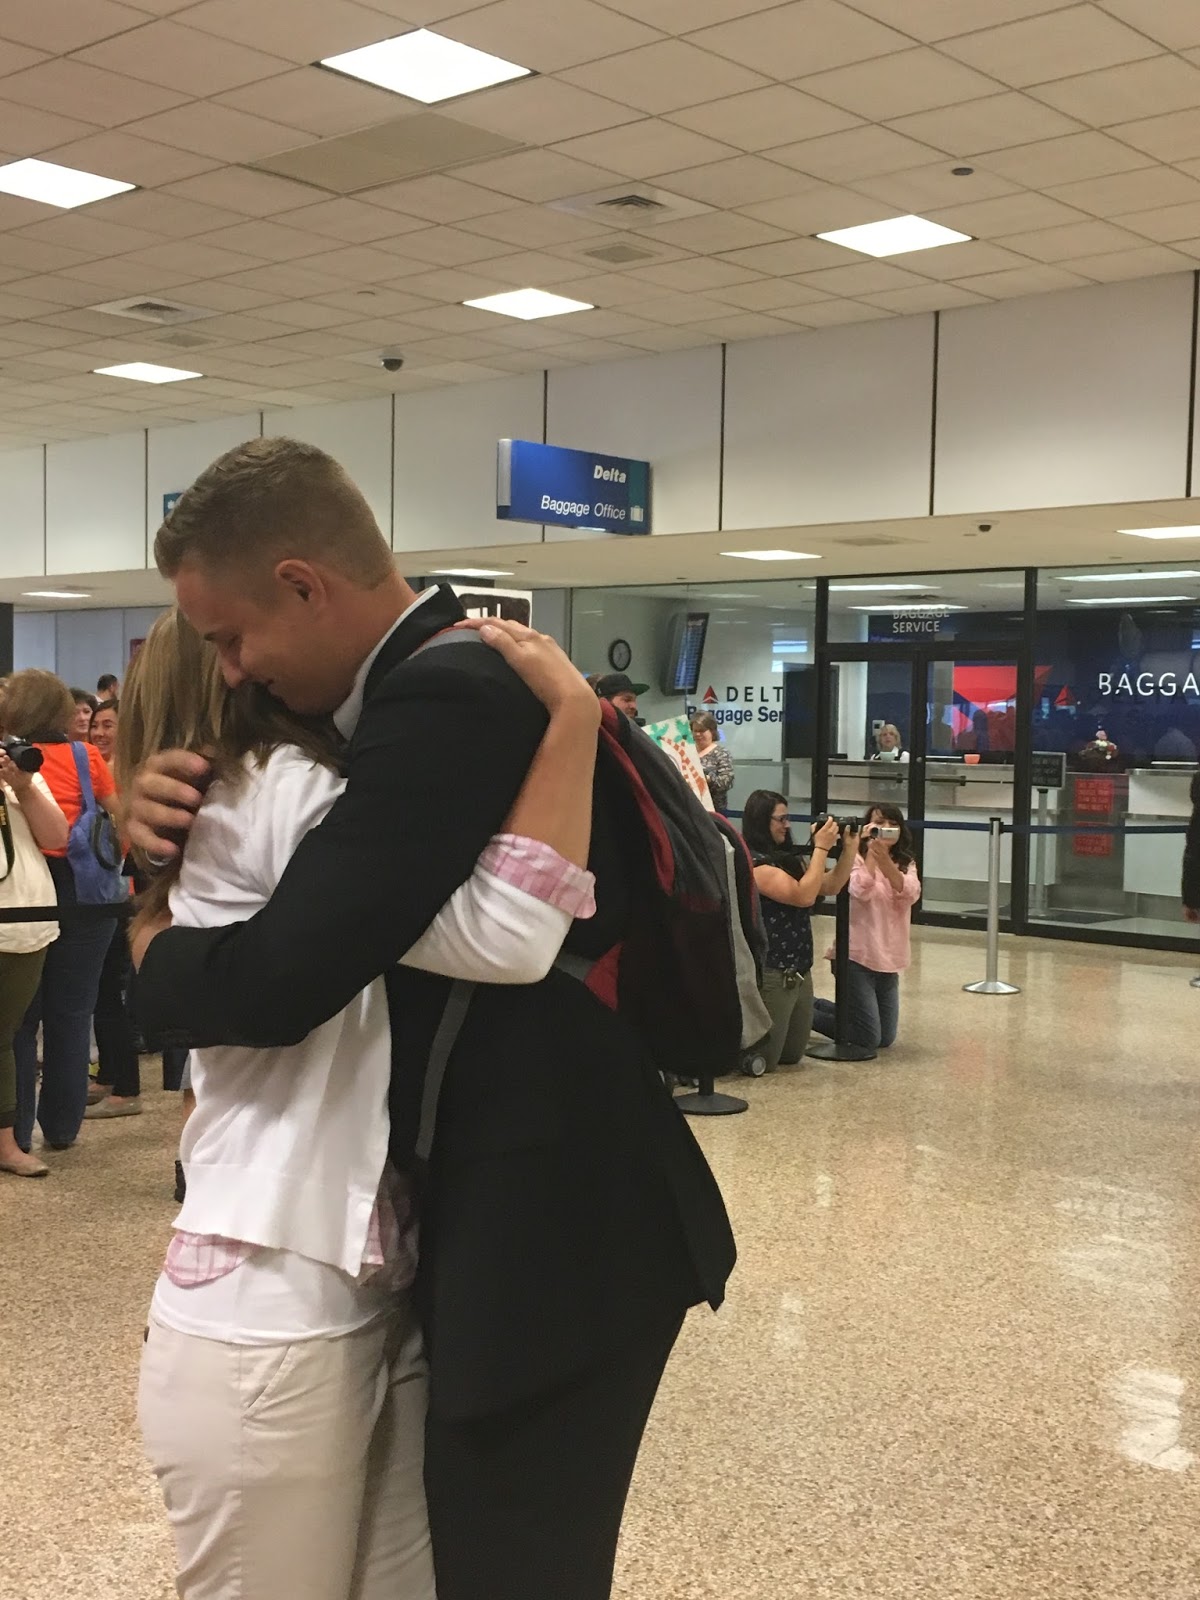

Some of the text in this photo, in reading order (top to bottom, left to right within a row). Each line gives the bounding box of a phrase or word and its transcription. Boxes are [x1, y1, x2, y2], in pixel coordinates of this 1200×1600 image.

[593, 465, 627, 484] Delta
[540, 495, 626, 520] Baggage Office
[892, 621, 940, 633] SERVICE
[1098, 672, 1200, 696] BAGGA
[726, 686, 783, 702] DELT
[687, 706, 753, 725] Bgage
